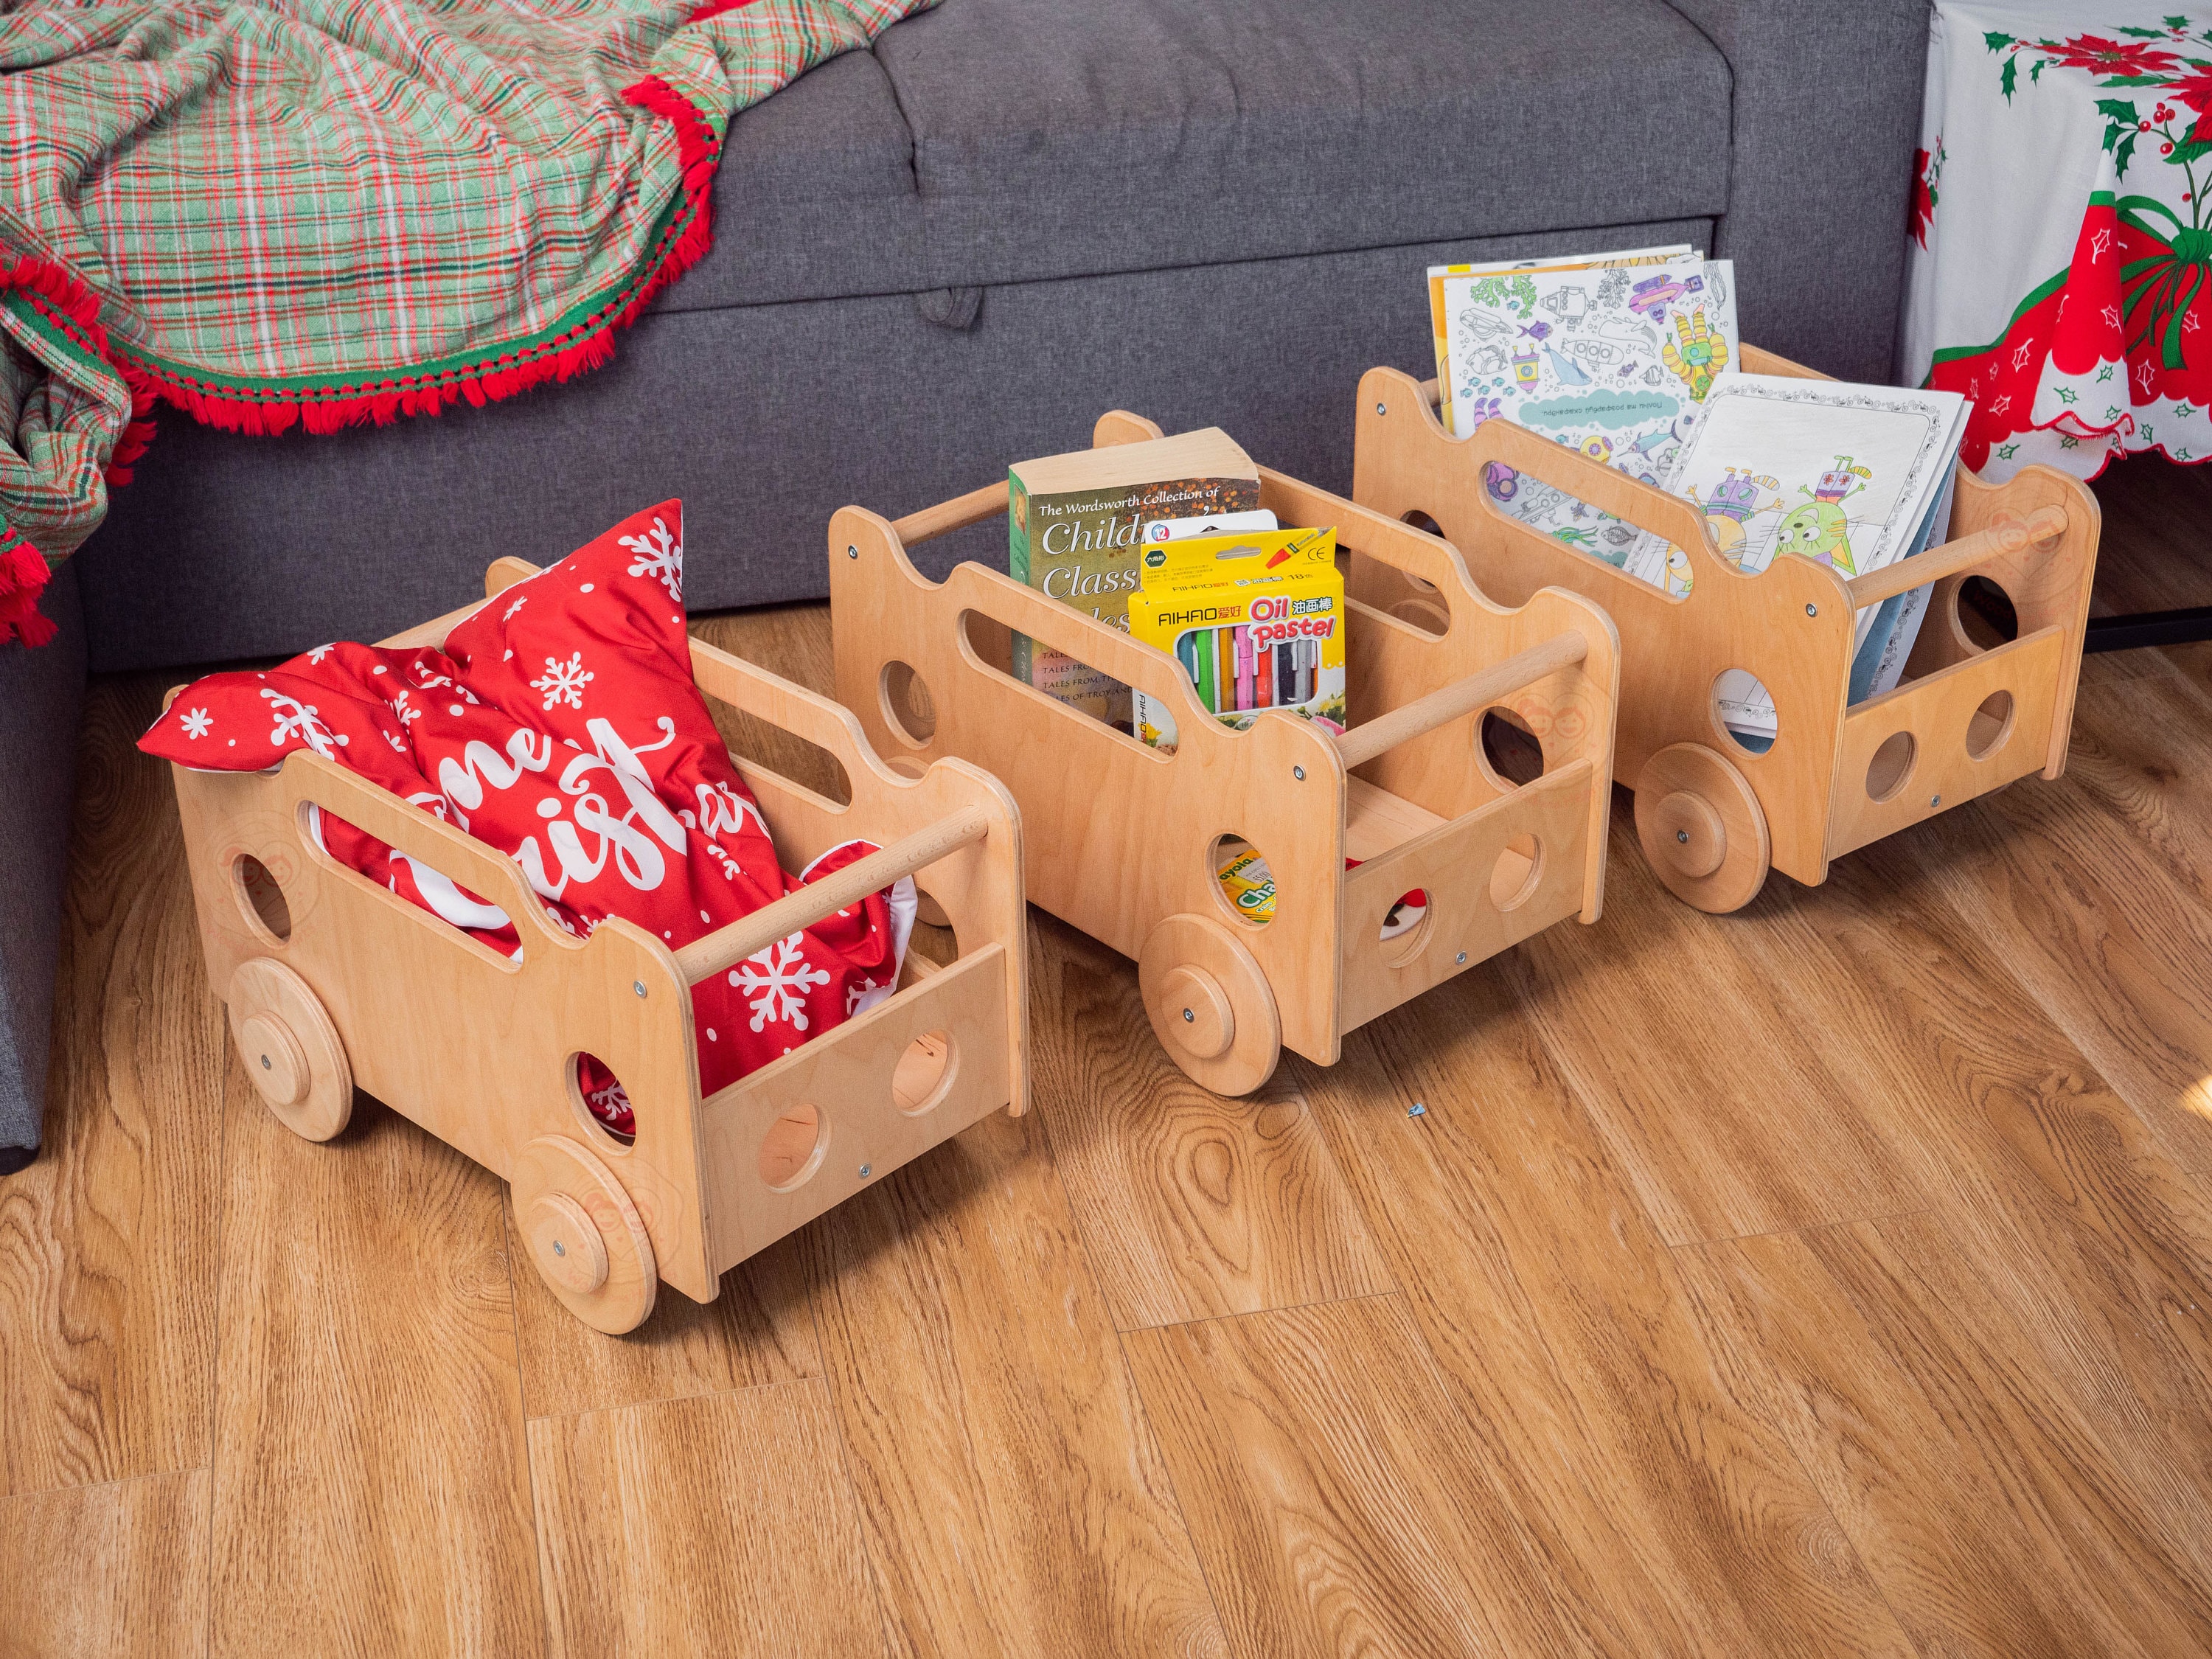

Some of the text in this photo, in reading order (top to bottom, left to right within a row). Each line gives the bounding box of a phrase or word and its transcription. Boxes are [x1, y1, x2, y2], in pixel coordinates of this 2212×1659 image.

[1038, 486, 1221, 516] The Wordsworth Collection of
[1153, 527, 1167, 540] 12
[1250, 597, 1290, 622] Oil
[1292, 597, 1333, 616] 油画棒
[1043, 663, 1092, 674] TALES FRO
[1043, 680, 1070, 689] TALES
[1073, 677, 1099, 686] FROM
[1073, 693, 1085, 701] OF
[1087, 689, 1112, 699] TROY
[1219, 858, 1254, 880] ayola
